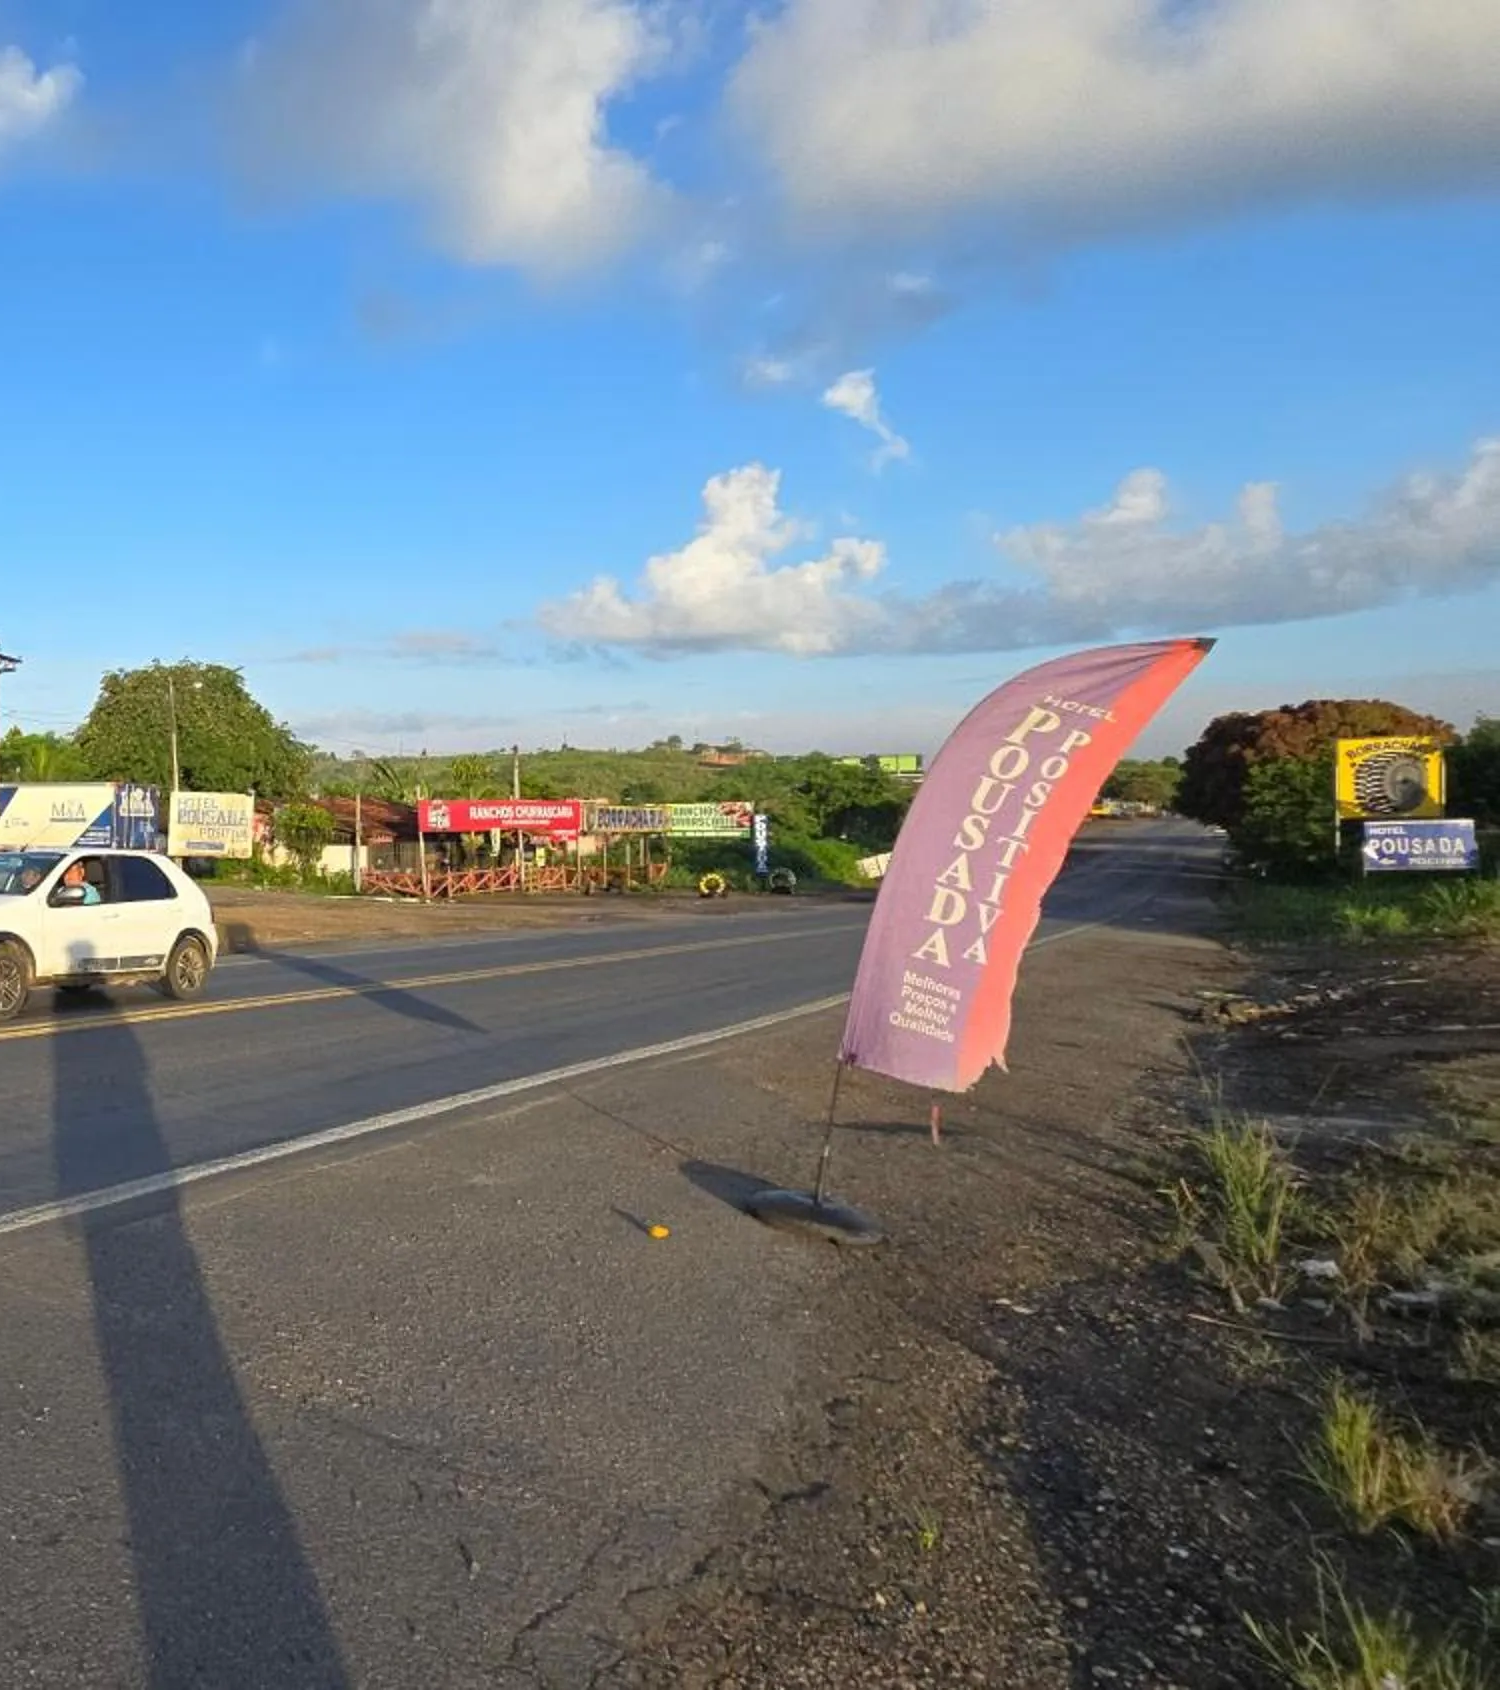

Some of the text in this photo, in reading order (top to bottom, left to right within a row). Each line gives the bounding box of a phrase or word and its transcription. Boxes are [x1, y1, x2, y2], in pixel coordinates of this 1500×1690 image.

[1043, 692, 1117, 723] HOTEL
[469, 806, 573, 819] RANCHOS CHURRASCARIA
[911, 705, 1061, 968] POUSADA
[1369, 826, 1407, 835] HOTEL
[961, 728, 1093, 966] POSITIVA
[1369, 837, 1466, 856] POUSADA
[903, 970, 961, 1001] Melhores
[889, 1011, 956, 1043] Qualidade
[903, 1001, 950, 1025] Melhor
